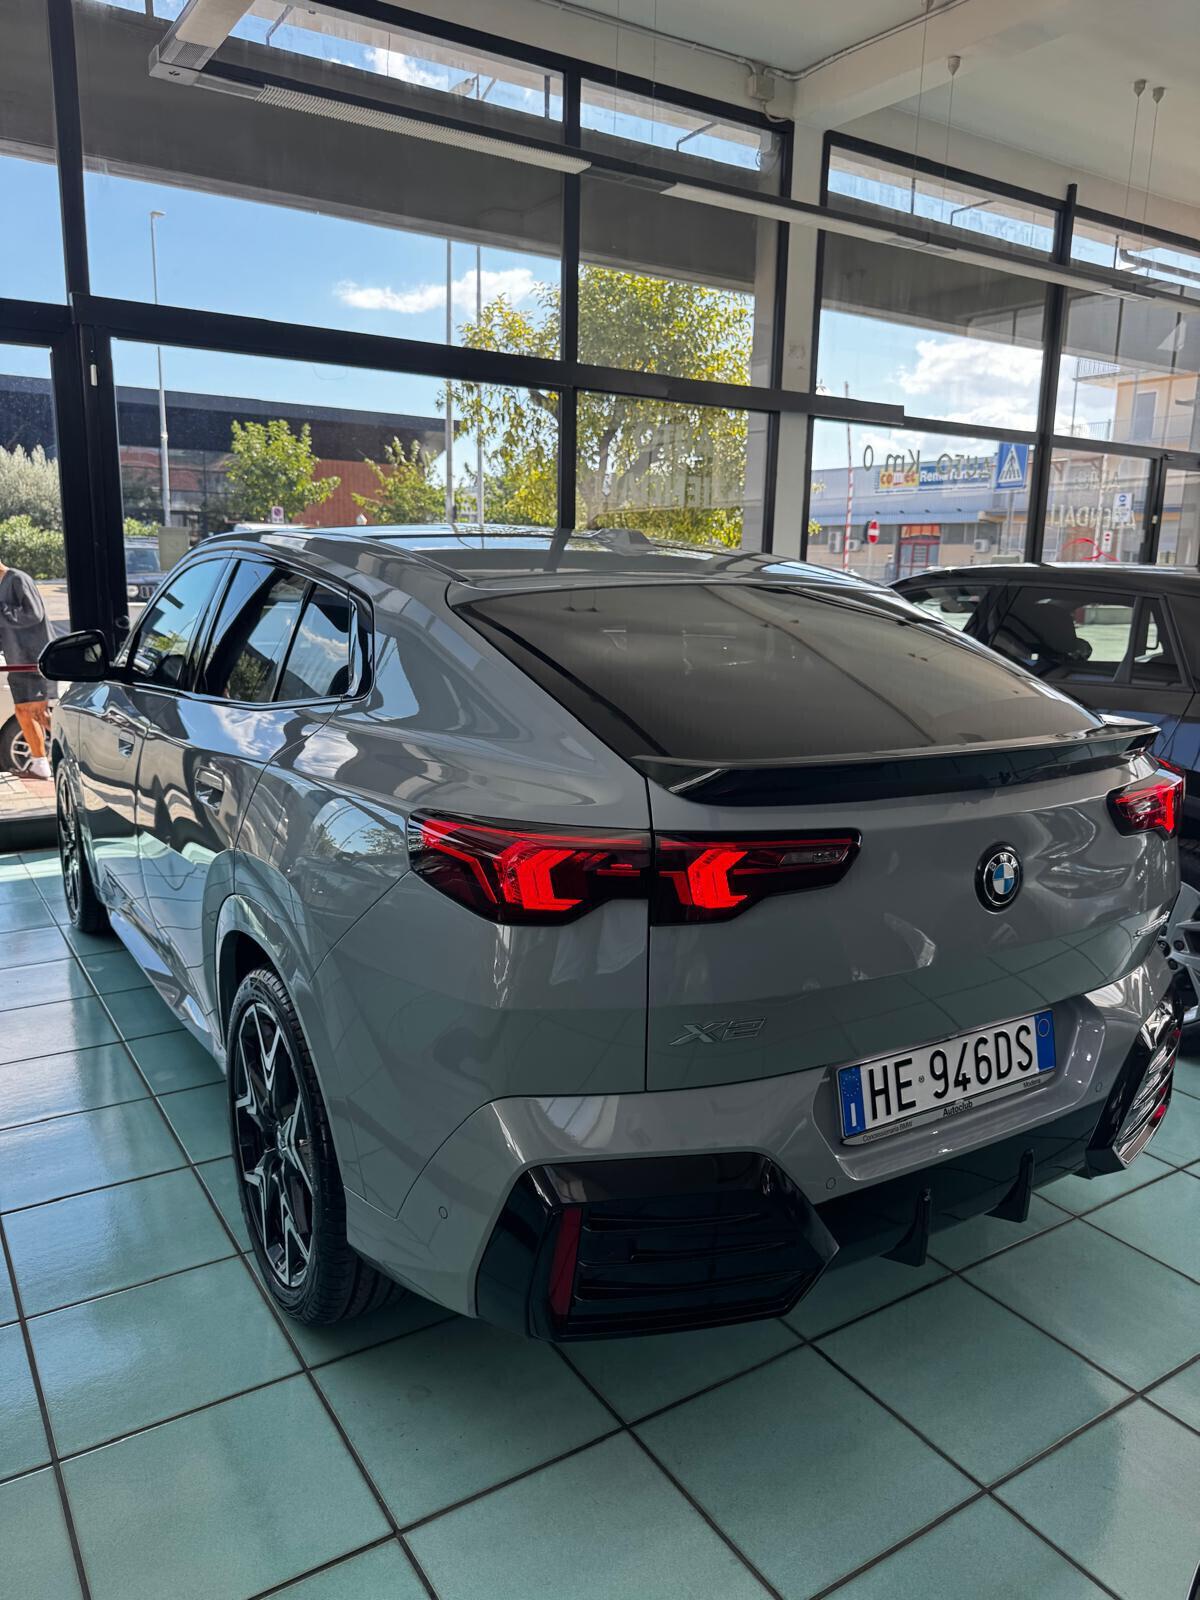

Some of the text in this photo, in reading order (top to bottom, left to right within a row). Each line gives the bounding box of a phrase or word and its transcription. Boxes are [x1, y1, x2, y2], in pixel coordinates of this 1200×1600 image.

[990, 852, 1018, 872] BMW
[668, 1017, 766, 1046] X2
[868, 1024, 1033, 1121] HE 946DS
[943, 1100, 973, 1118] Autoclub
